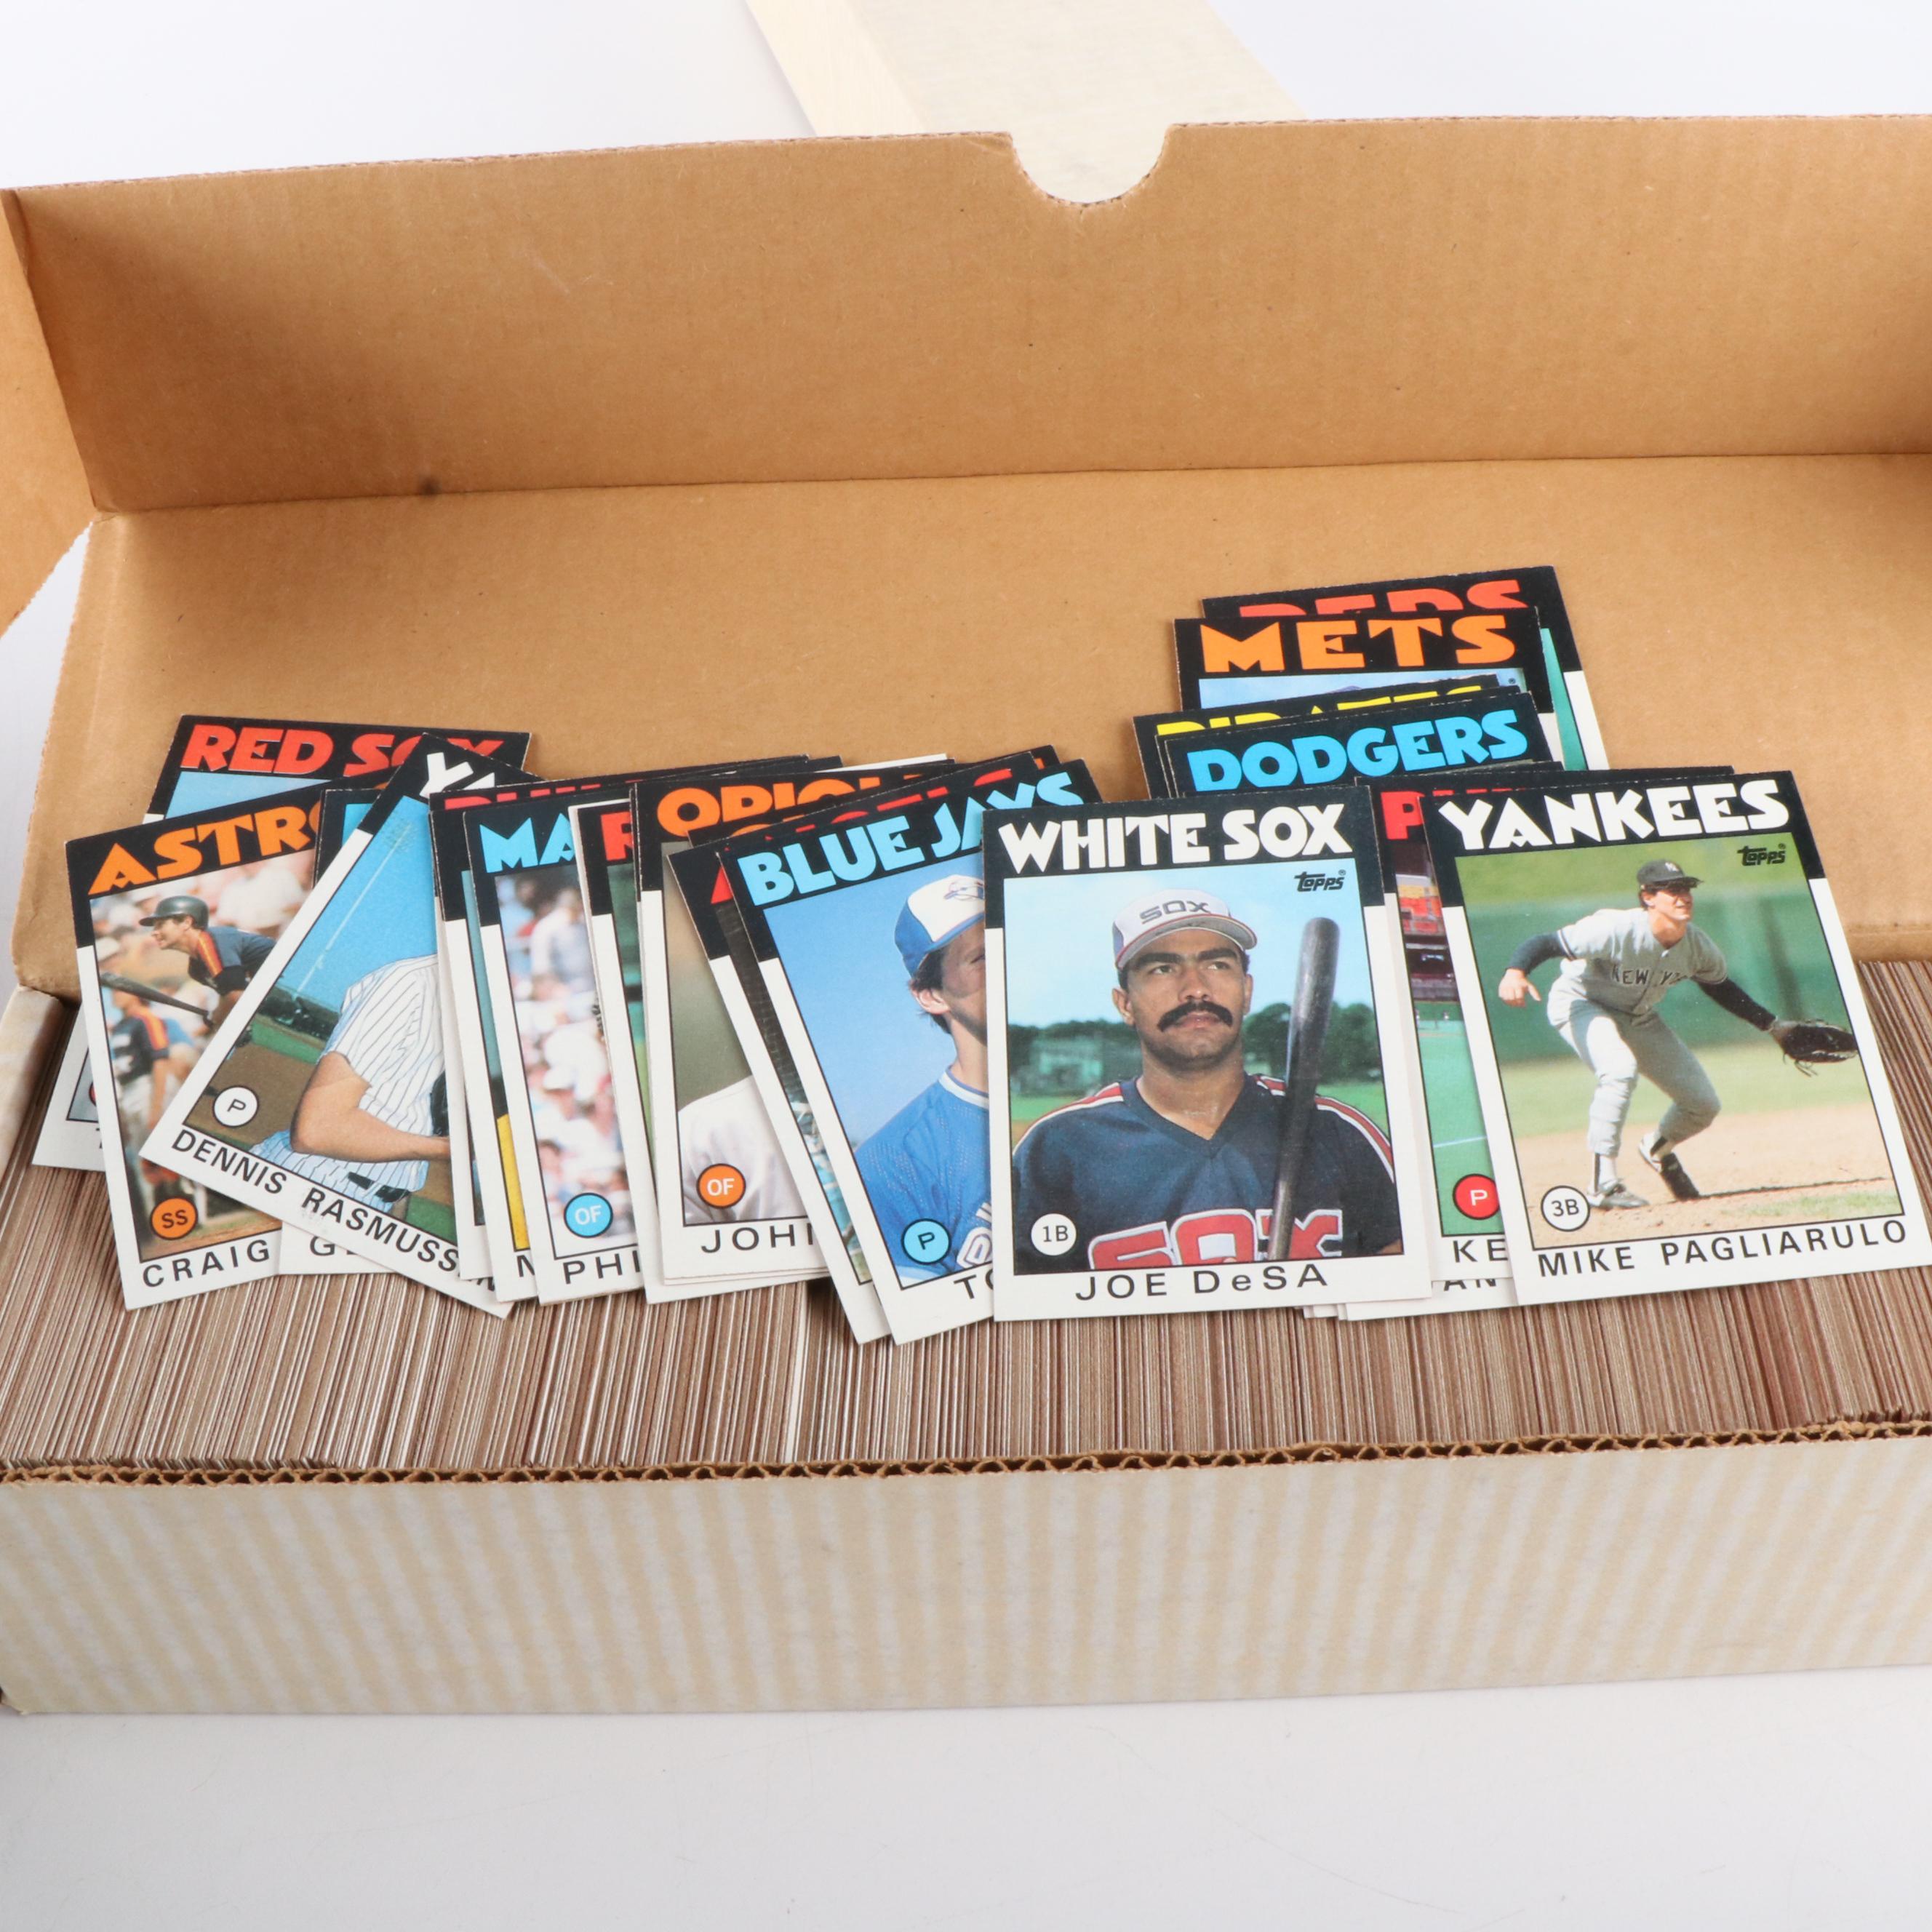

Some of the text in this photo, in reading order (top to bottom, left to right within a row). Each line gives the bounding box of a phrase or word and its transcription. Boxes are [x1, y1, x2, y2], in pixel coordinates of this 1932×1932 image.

[1200, 615, 1516, 673] METS
[180, 724, 335, 772] RED
[1186, 709, 1528, 791] DODGERS
[1438, 780, 1789, 850] YANKEES
[999, 813, 1210, 874] WHITE
[1221, 803, 1353, 861] SOX
[737, 815, 925, 906] BLUE
[1139, 899, 1210, 925] SOX
[227, 1098, 247, 1113] P
[171, 1129, 288, 1195] DENNIS
[707, 1178, 735, 1196] OF
[1470, 1189, 1488, 1206] P
[161, 1209, 188, 1229] SS
[574, 1205, 602, 1225] OF
[1551, 1199, 1580, 1217] 3B
[918, 1232, 935, 1250] P
[1042, 1225, 1069, 1242] 1B
[1538, 1219, 1906, 1277] MIKE PAGLIARULO
[143, 1240, 270, 1288] CRAIG
[1453, 1238, 1508, 1263] KE
[1075, 1264, 1328, 1301] JOE DeSA
